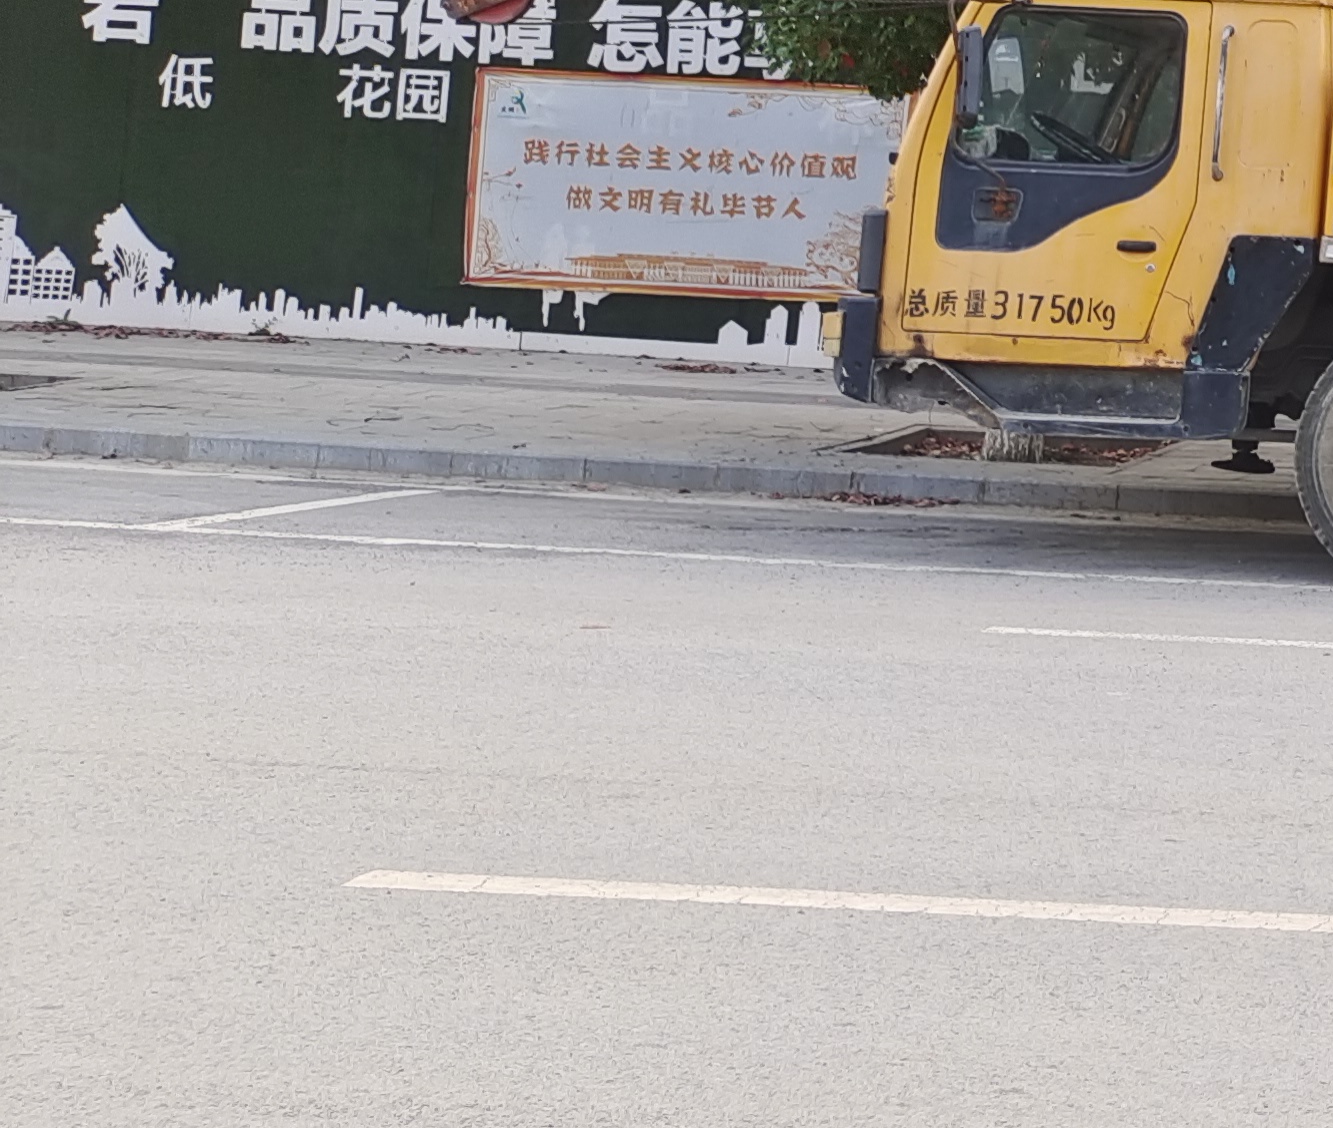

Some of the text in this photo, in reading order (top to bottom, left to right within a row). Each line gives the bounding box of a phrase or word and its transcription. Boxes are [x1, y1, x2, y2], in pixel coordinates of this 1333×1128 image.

[158, 54, 214, 109] 低
[336, 65, 451, 124] 花园
[523, 139, 858, 180] 践行社会主义核心价值观
[566, 184, 807, 221] 做文明有礼毕节人
